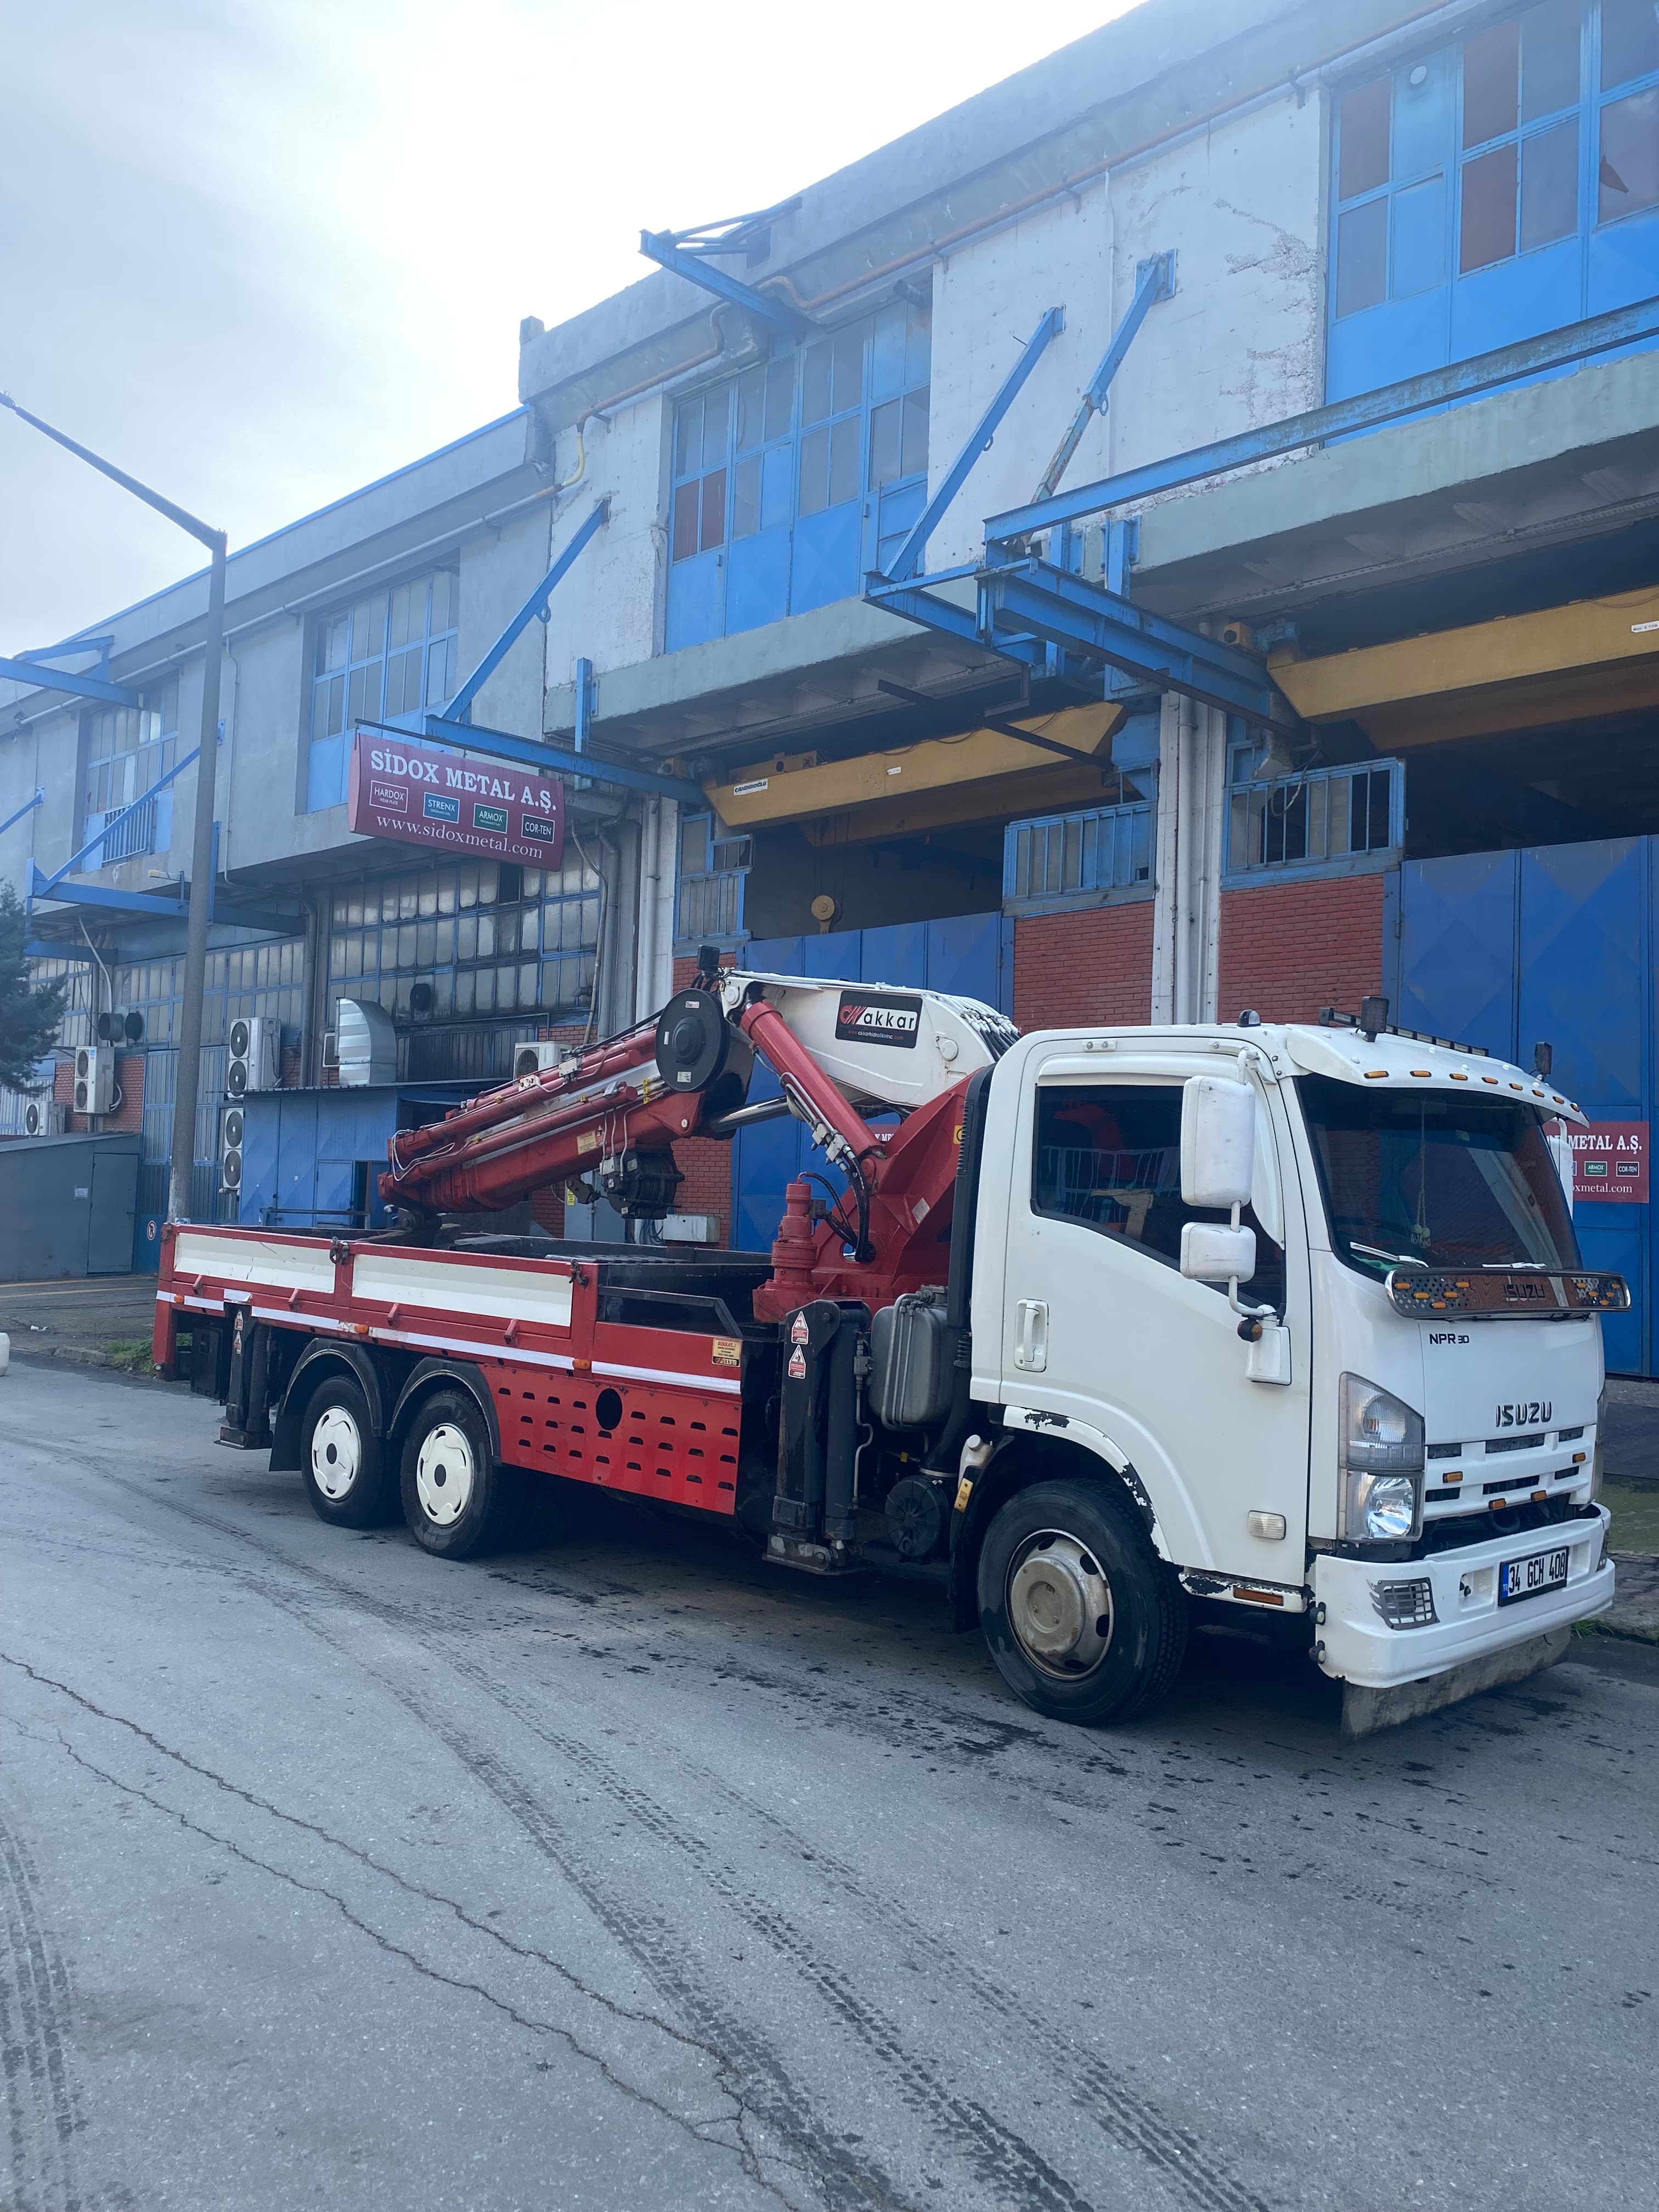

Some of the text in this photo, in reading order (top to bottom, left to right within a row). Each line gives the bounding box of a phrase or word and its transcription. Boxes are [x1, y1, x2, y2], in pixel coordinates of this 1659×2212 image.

[371, 748, 557, 814] SİDOX METAL A.Ş.
[374, 787, 404, 802] HARDOX
[427, 799, 455, 812] STRENX
[479, 810, 503, 822] ARMOX
[376, 816, 543, 859] www.sidoxmetal.com
[524, 822, 552, 836] COR-TEN
[864, 1011, 915, 1029] akkar
[1568, 1135, 1642, 1154] METAL A.Ş.
[1504, 1284, 1545, 1302] ISUZU
[1429, 1334, 1457, 1345] NPR
[1496, 1401, 1552, 1427] ISUZU
[1509, 1552, 1566, 1594] 34 GCH 408
